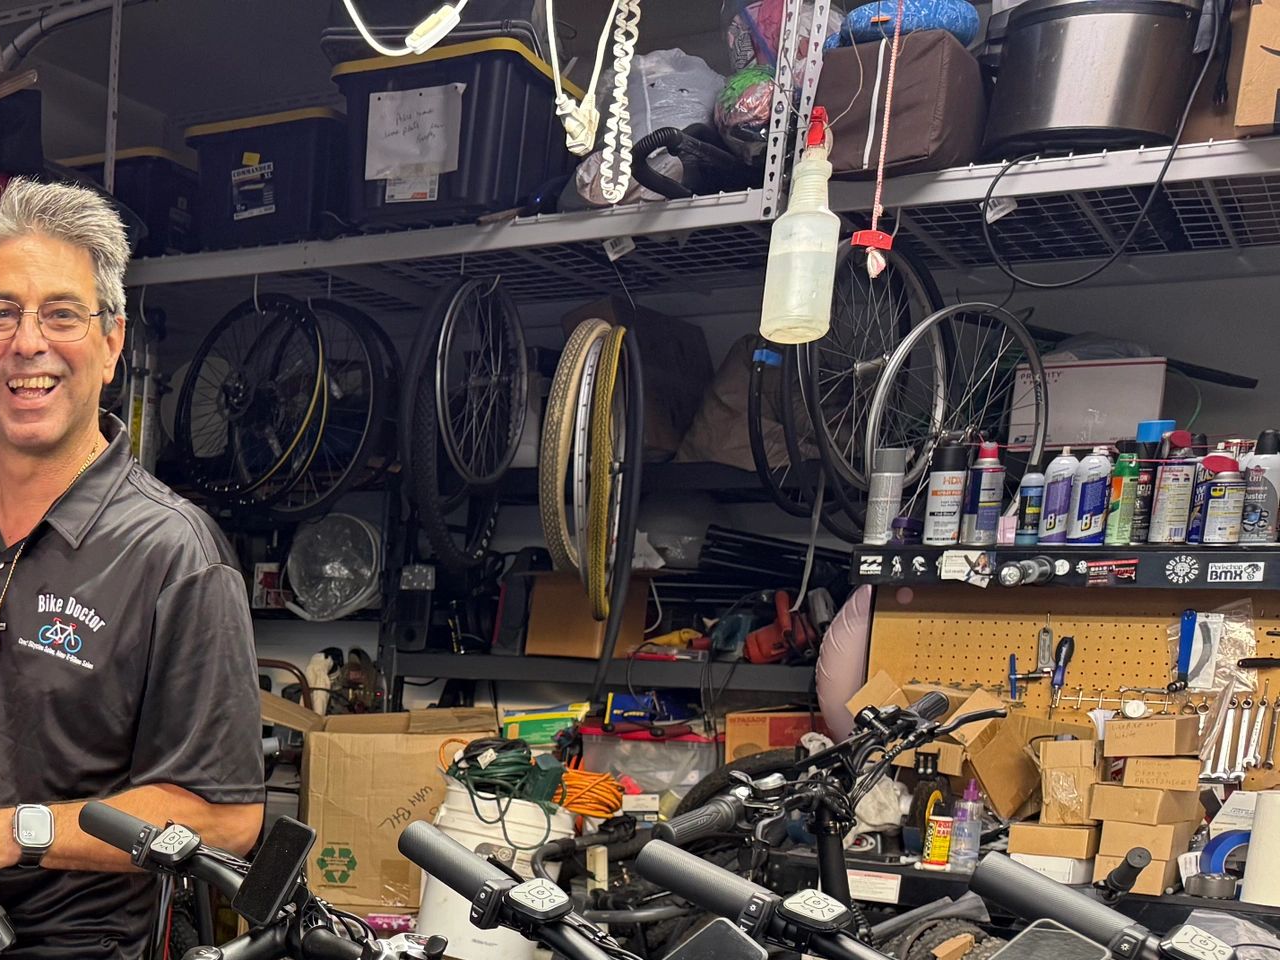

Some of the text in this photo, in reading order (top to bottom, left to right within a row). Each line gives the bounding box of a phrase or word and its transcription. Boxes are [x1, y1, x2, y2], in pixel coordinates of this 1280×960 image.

[233, 163, 273, 178] COMMANDER
[1210, 563, 1244, 572] Porkchop
[1209, 570, 1243, 581] BMX
[37, 594, 106, 632] Bike Doctor
